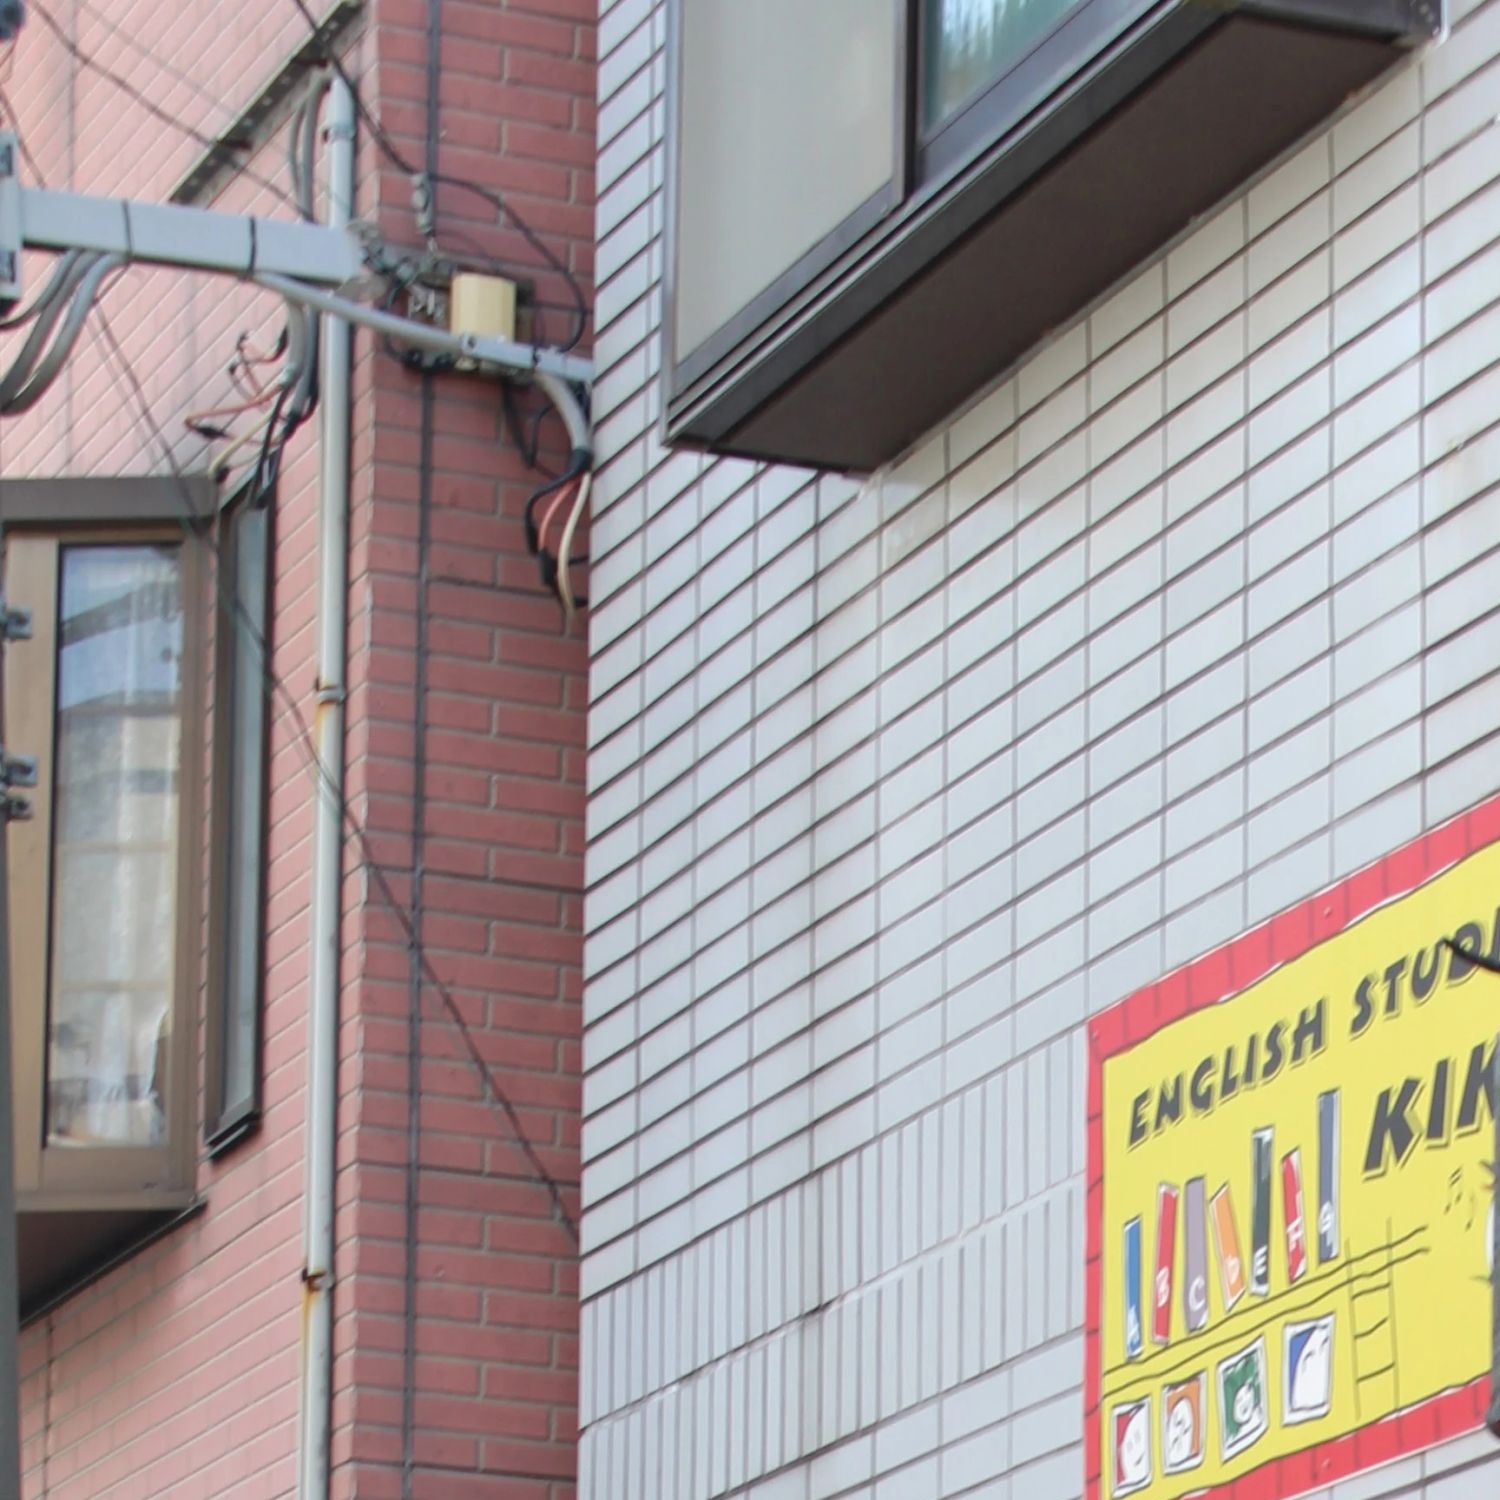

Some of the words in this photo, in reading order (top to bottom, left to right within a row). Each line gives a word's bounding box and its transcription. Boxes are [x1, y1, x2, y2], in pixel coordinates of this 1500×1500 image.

[1128, 998, 1328, 1150] ENGLISH
[1155, 1267, 1169, 1307] B
[1188, 1277, 1204, 1312] C
[1252, 1246, 1269, 1277] E
